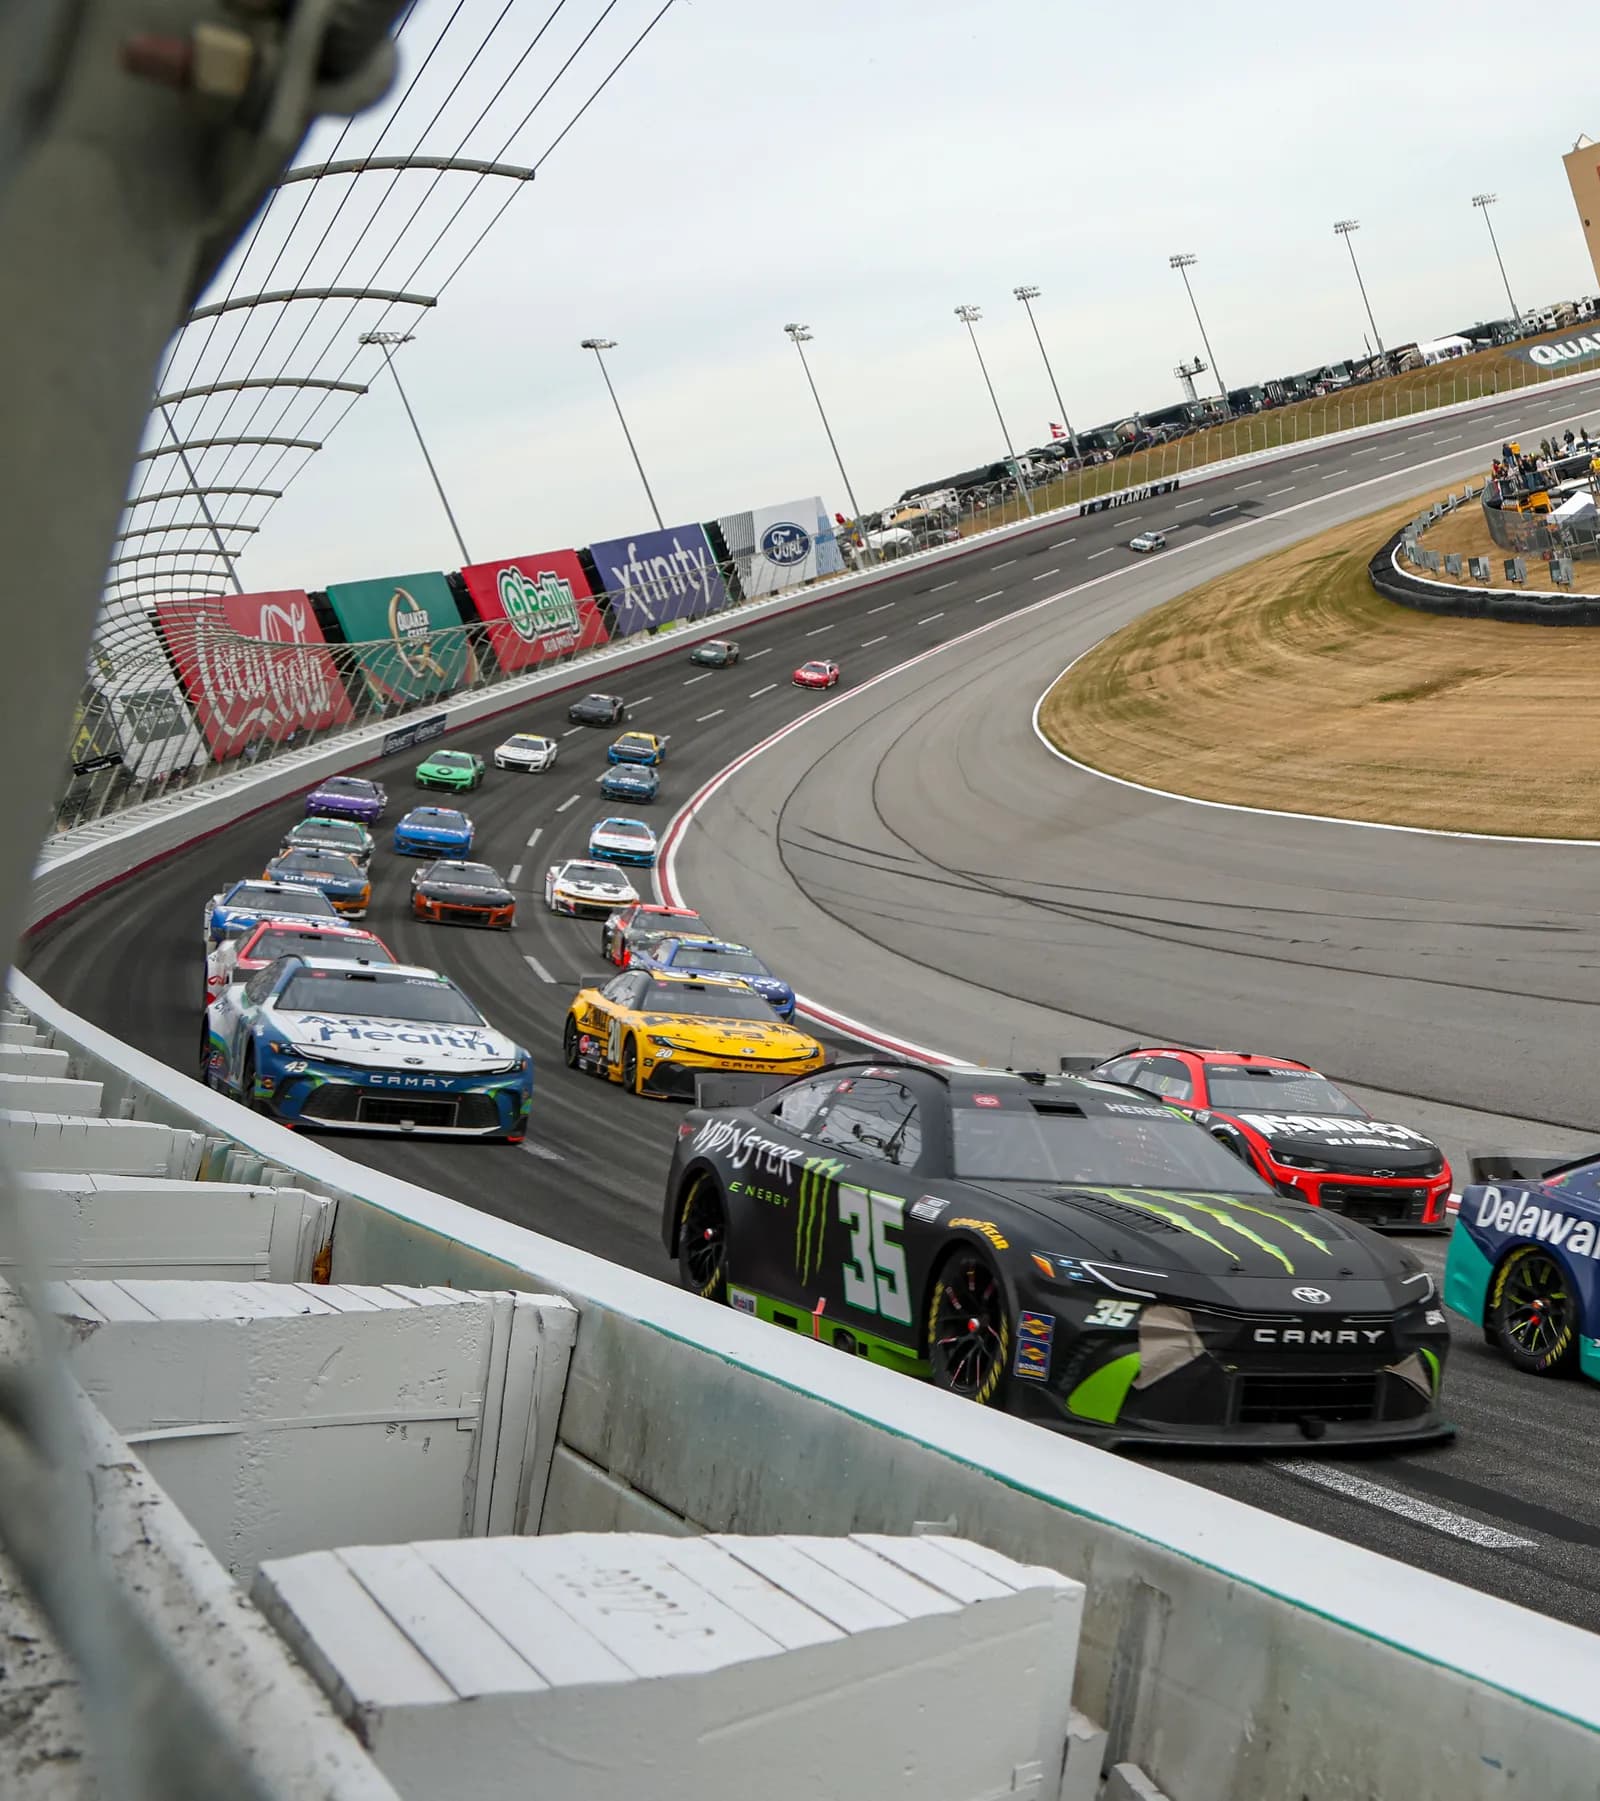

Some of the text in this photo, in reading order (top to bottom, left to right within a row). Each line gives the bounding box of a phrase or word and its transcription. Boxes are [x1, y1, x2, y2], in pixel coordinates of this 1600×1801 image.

[1109, 487, 1152, 508] ATLANTA
[771, 529, 804, 560] Ford
[611, 536, 711, 621] xfinity
[396, 608, 430, 632] QUAKER
[284, 874, 308, 882] CITY
[318, 1026, 500, 1057] Health
[655, 1048, 673, 1059] 20
[720, 1060, 777, 1071] CAMRY
[369, 1075, 455, 1088] CAMRY
[729, 1181, 791, 1209] ENERGY
[837, 1181, 914, 1327] 35
[1083, 1299, 1142, 1328] 35
[1253, 1328, 1386, 1344] CAMRY
